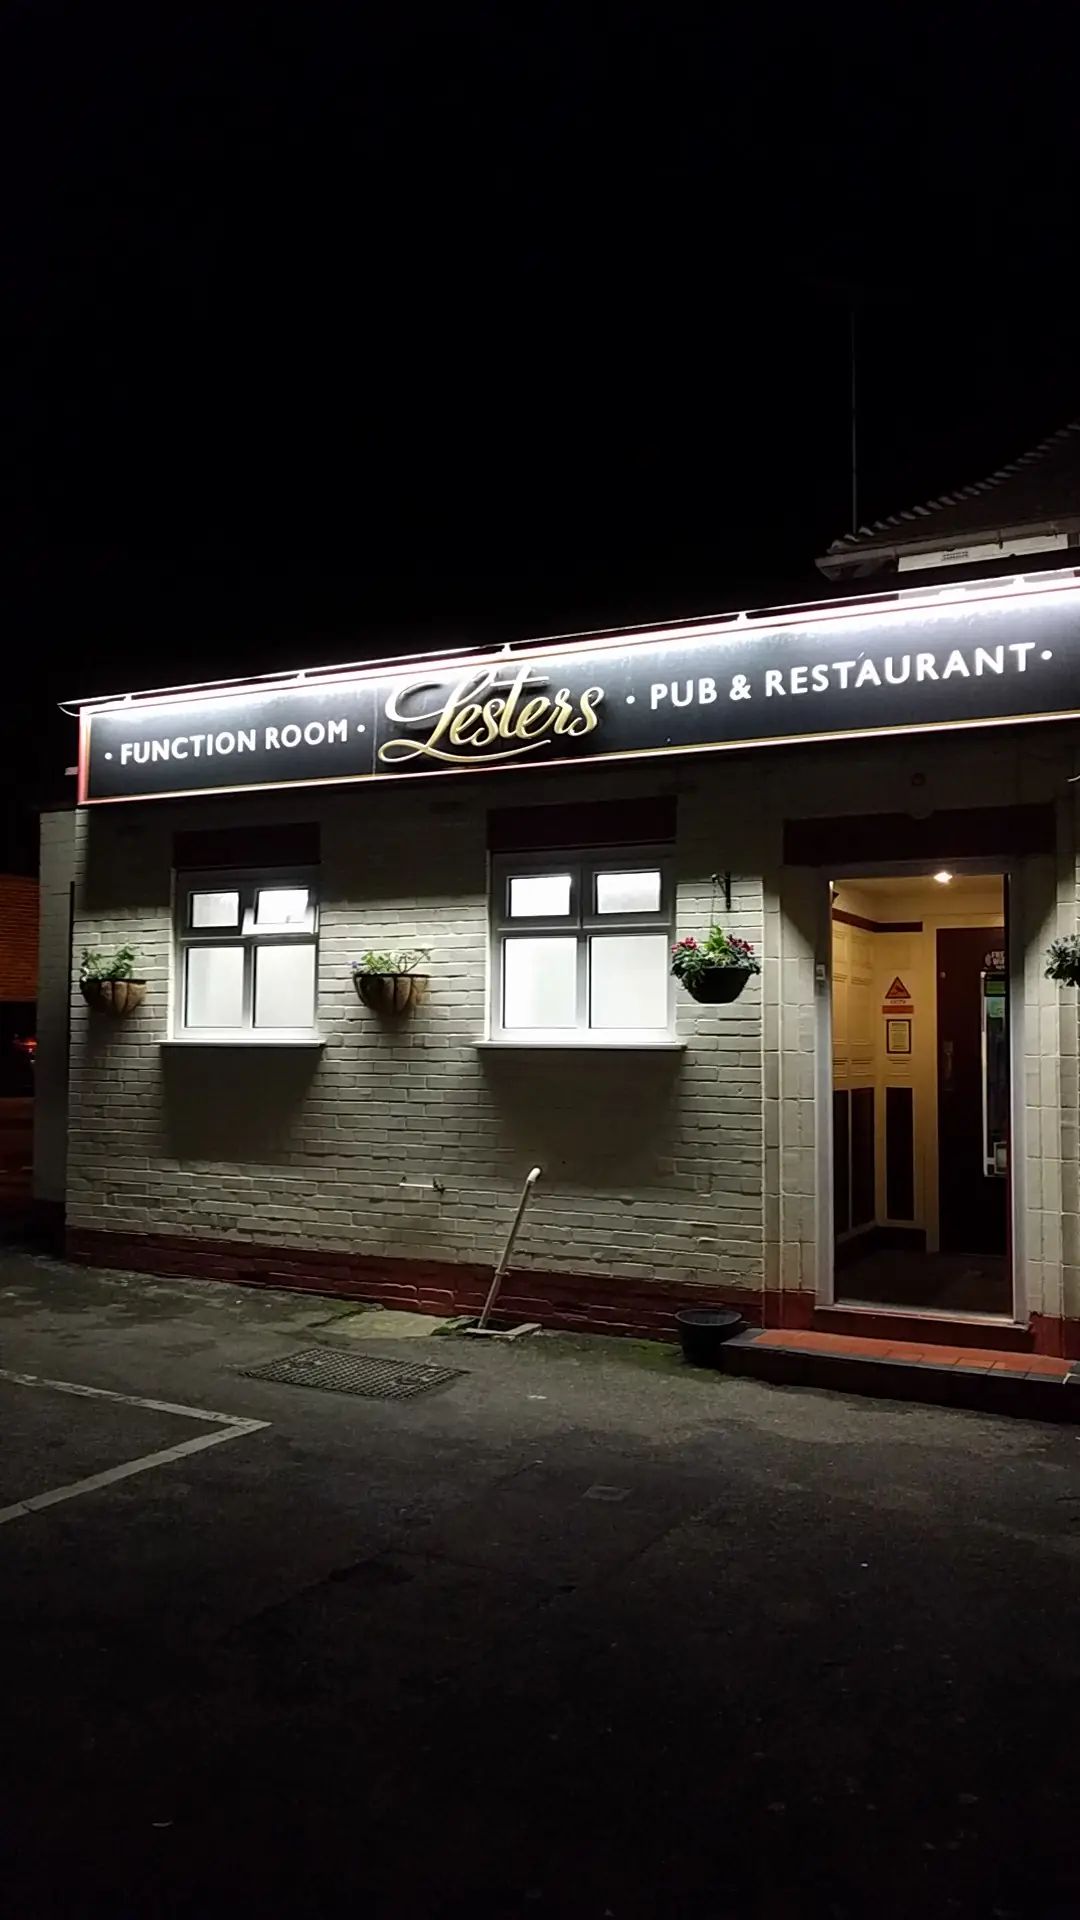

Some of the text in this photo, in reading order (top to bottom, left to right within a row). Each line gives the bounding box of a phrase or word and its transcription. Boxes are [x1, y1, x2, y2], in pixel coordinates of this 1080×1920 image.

[650, 642, 1036, 710] PUB & RESTAURANT
[120, 719, 348, 765] FUNCTION ROOM
[378, 664, 605, 763] Lesters
